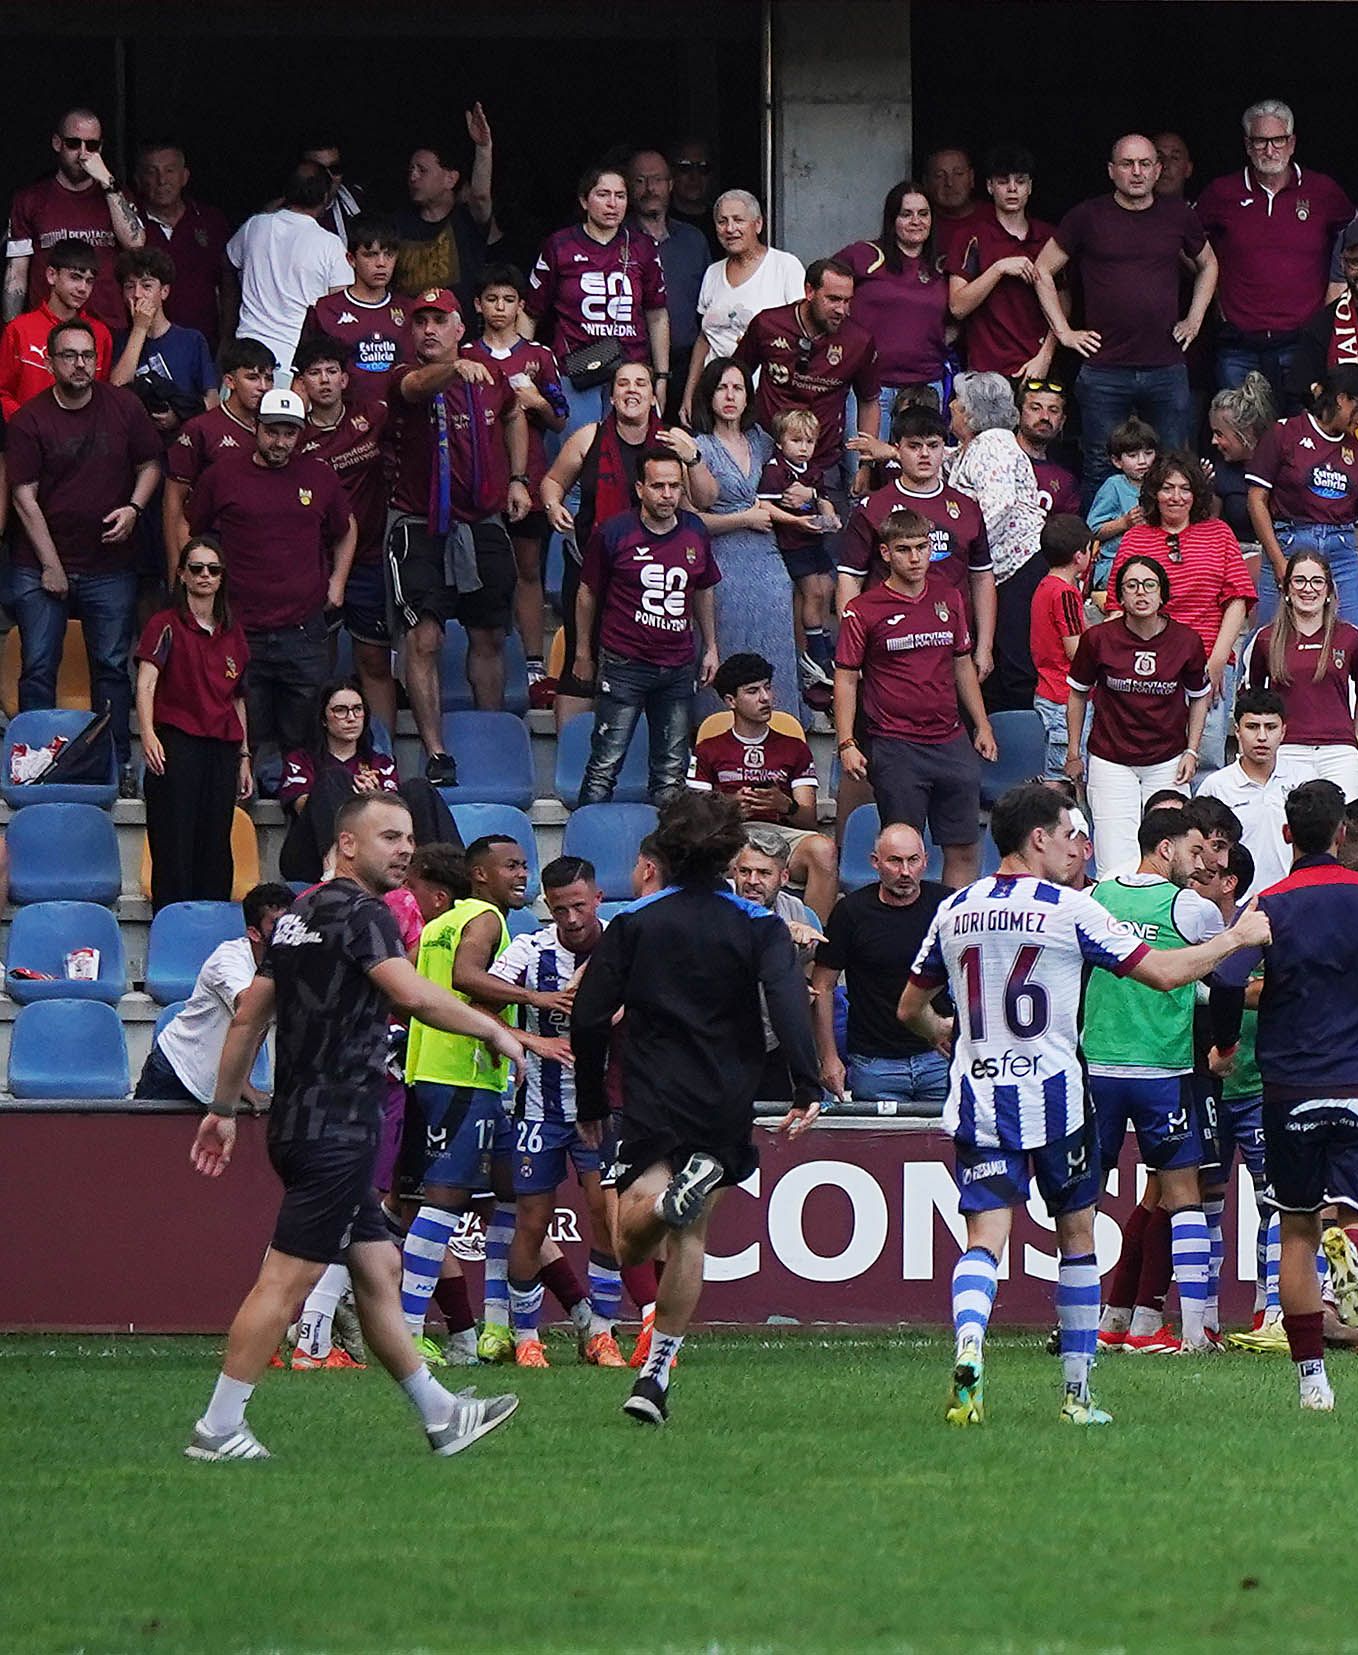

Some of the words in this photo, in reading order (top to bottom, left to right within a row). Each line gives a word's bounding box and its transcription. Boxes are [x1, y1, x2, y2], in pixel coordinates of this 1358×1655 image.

[954, 912, 985, 936] ADRI
[988, 908, 1048, 934] GÓMEZ
[957, 943, 1052, 1043] 16
[970, 1048, 1044, 1079] esfer
[516, 1120, 544, 1154] 26
